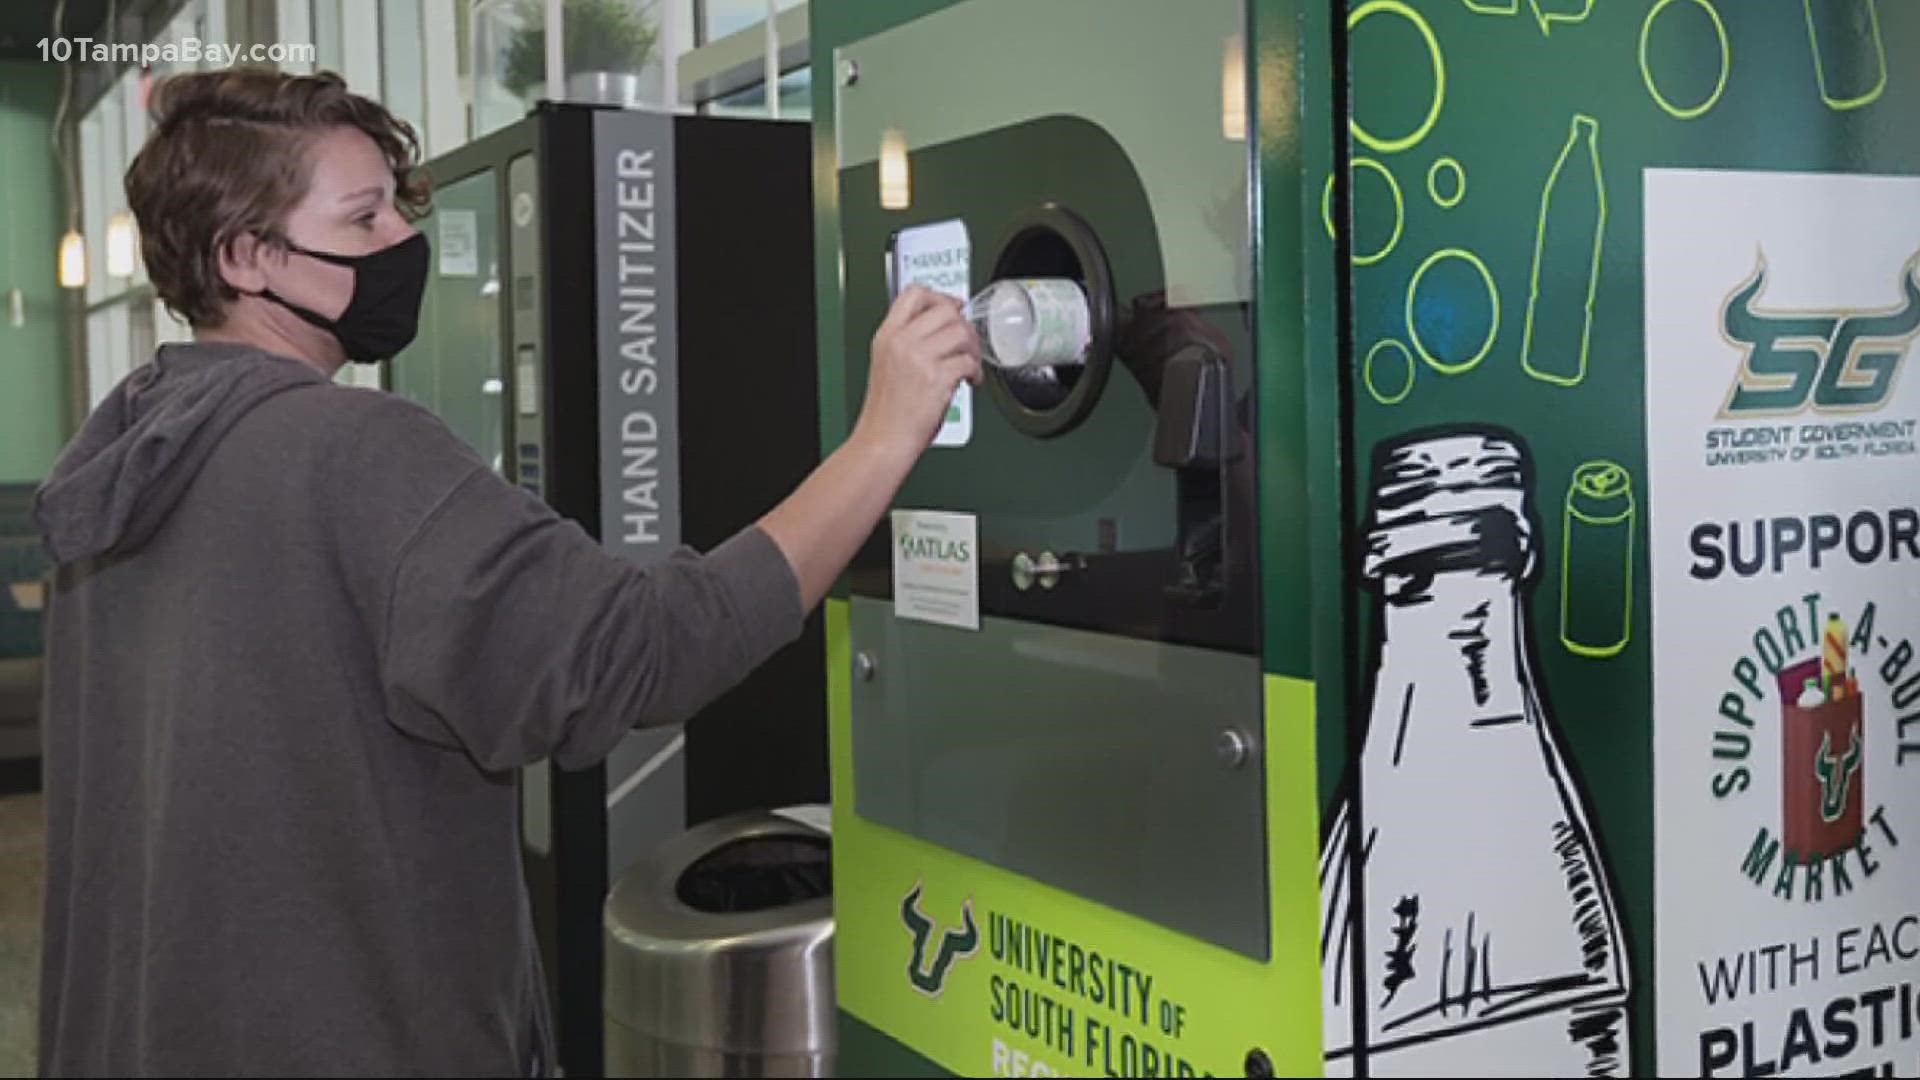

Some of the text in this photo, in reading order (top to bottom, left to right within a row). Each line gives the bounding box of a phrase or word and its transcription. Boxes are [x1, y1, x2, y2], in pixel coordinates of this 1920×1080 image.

[617, 148, 660, 544] HAND SANITIZER
[1706, 419, 1916, 449] STUDENT GOVERNMENT
[1706, 449, 1786, 466] UNIVERSITY
[914, 537, 970, 563] ATLAS
[1688, 507, 1920, 581] SUPPOR
[1712, 592, 1821, 799] SUPPORT
[1740, 804, 1899, 902] MARKET
[989, 911, 1185, 1039] UNIVERSITY OF
[1698, 915, 1920, 1005] WITH EAC
[990, 974, 1073, 1058] SOUTH
[1699, 982, 1920, 1078] PLASTI
